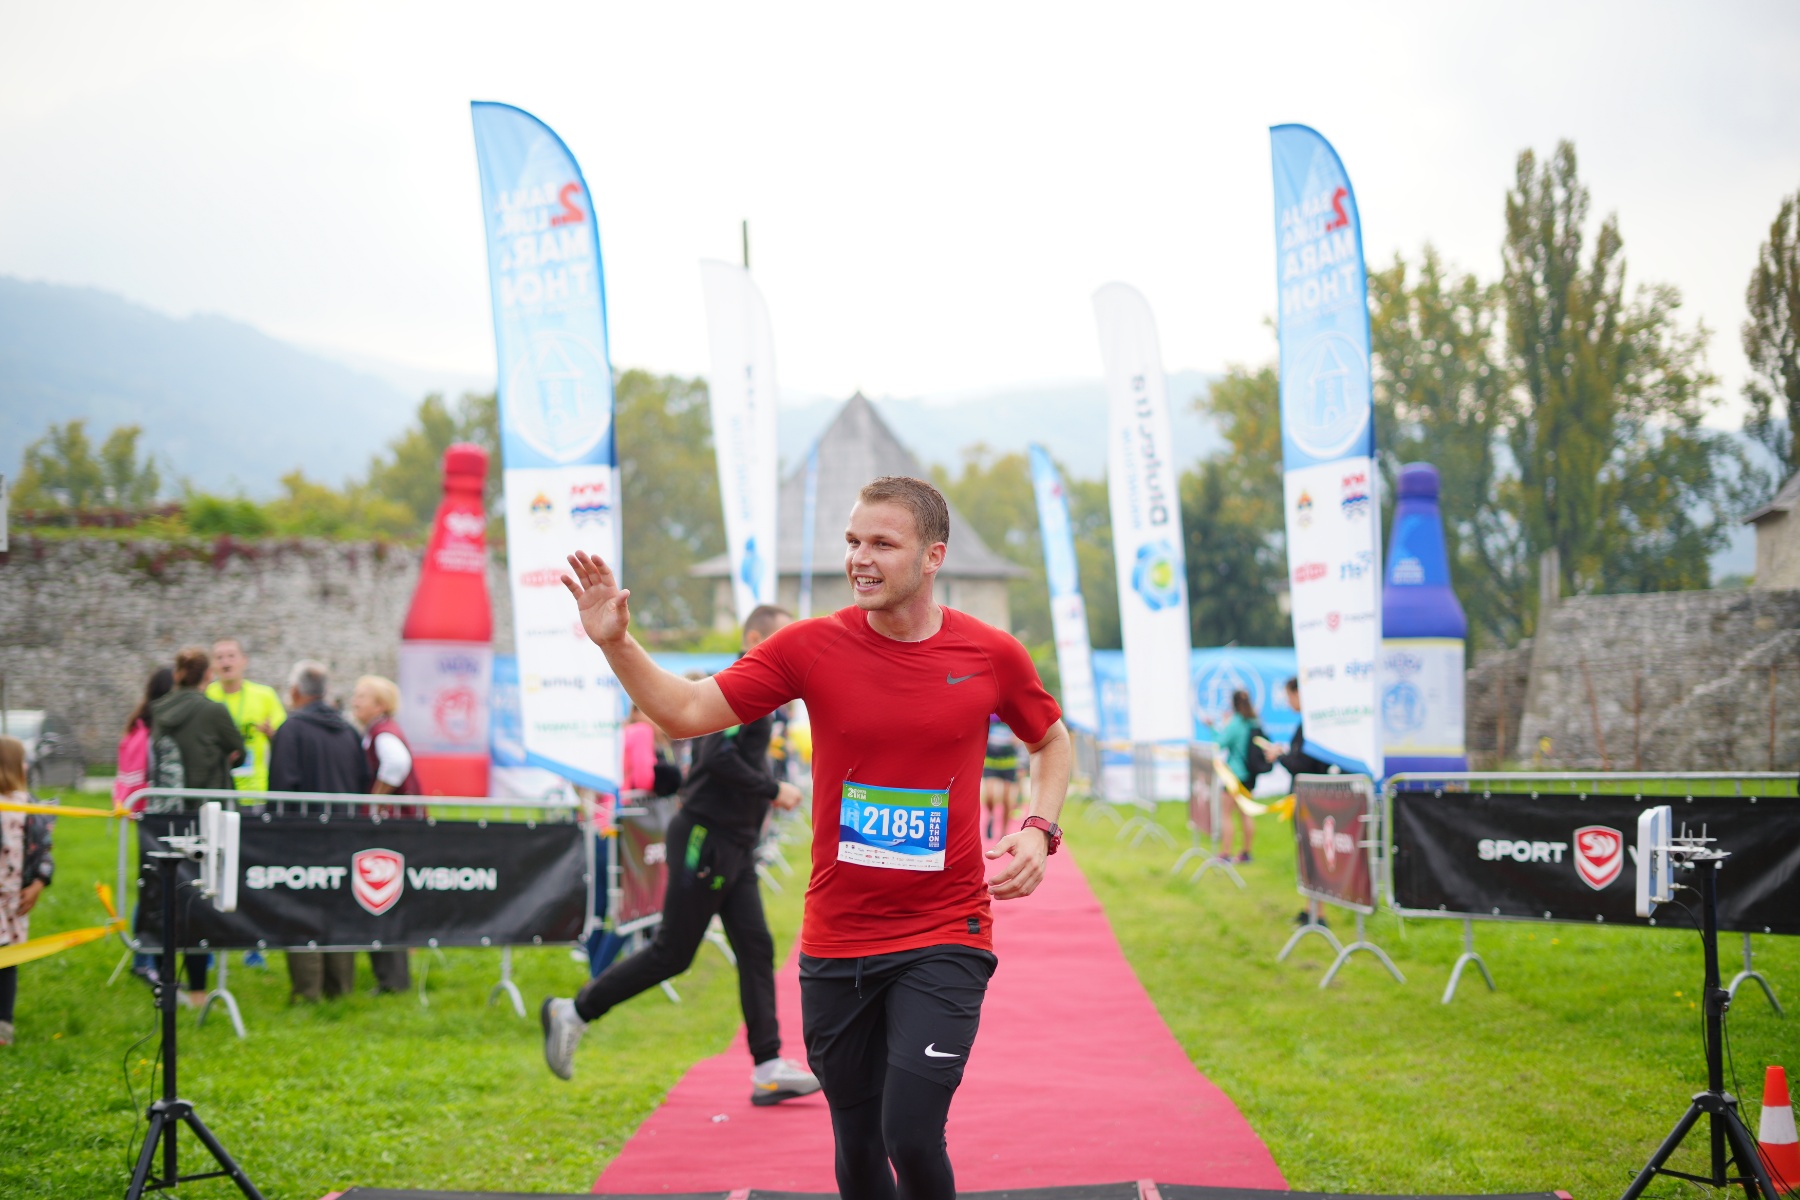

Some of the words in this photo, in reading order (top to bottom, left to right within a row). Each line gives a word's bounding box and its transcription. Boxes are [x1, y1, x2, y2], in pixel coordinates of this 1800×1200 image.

[862, 806, 925, 839] 2185
[1477, 838, 1568, 864] SPORT
[246, 865, 348, 890] SPORT
[406, 867, 497, 891] VISION
